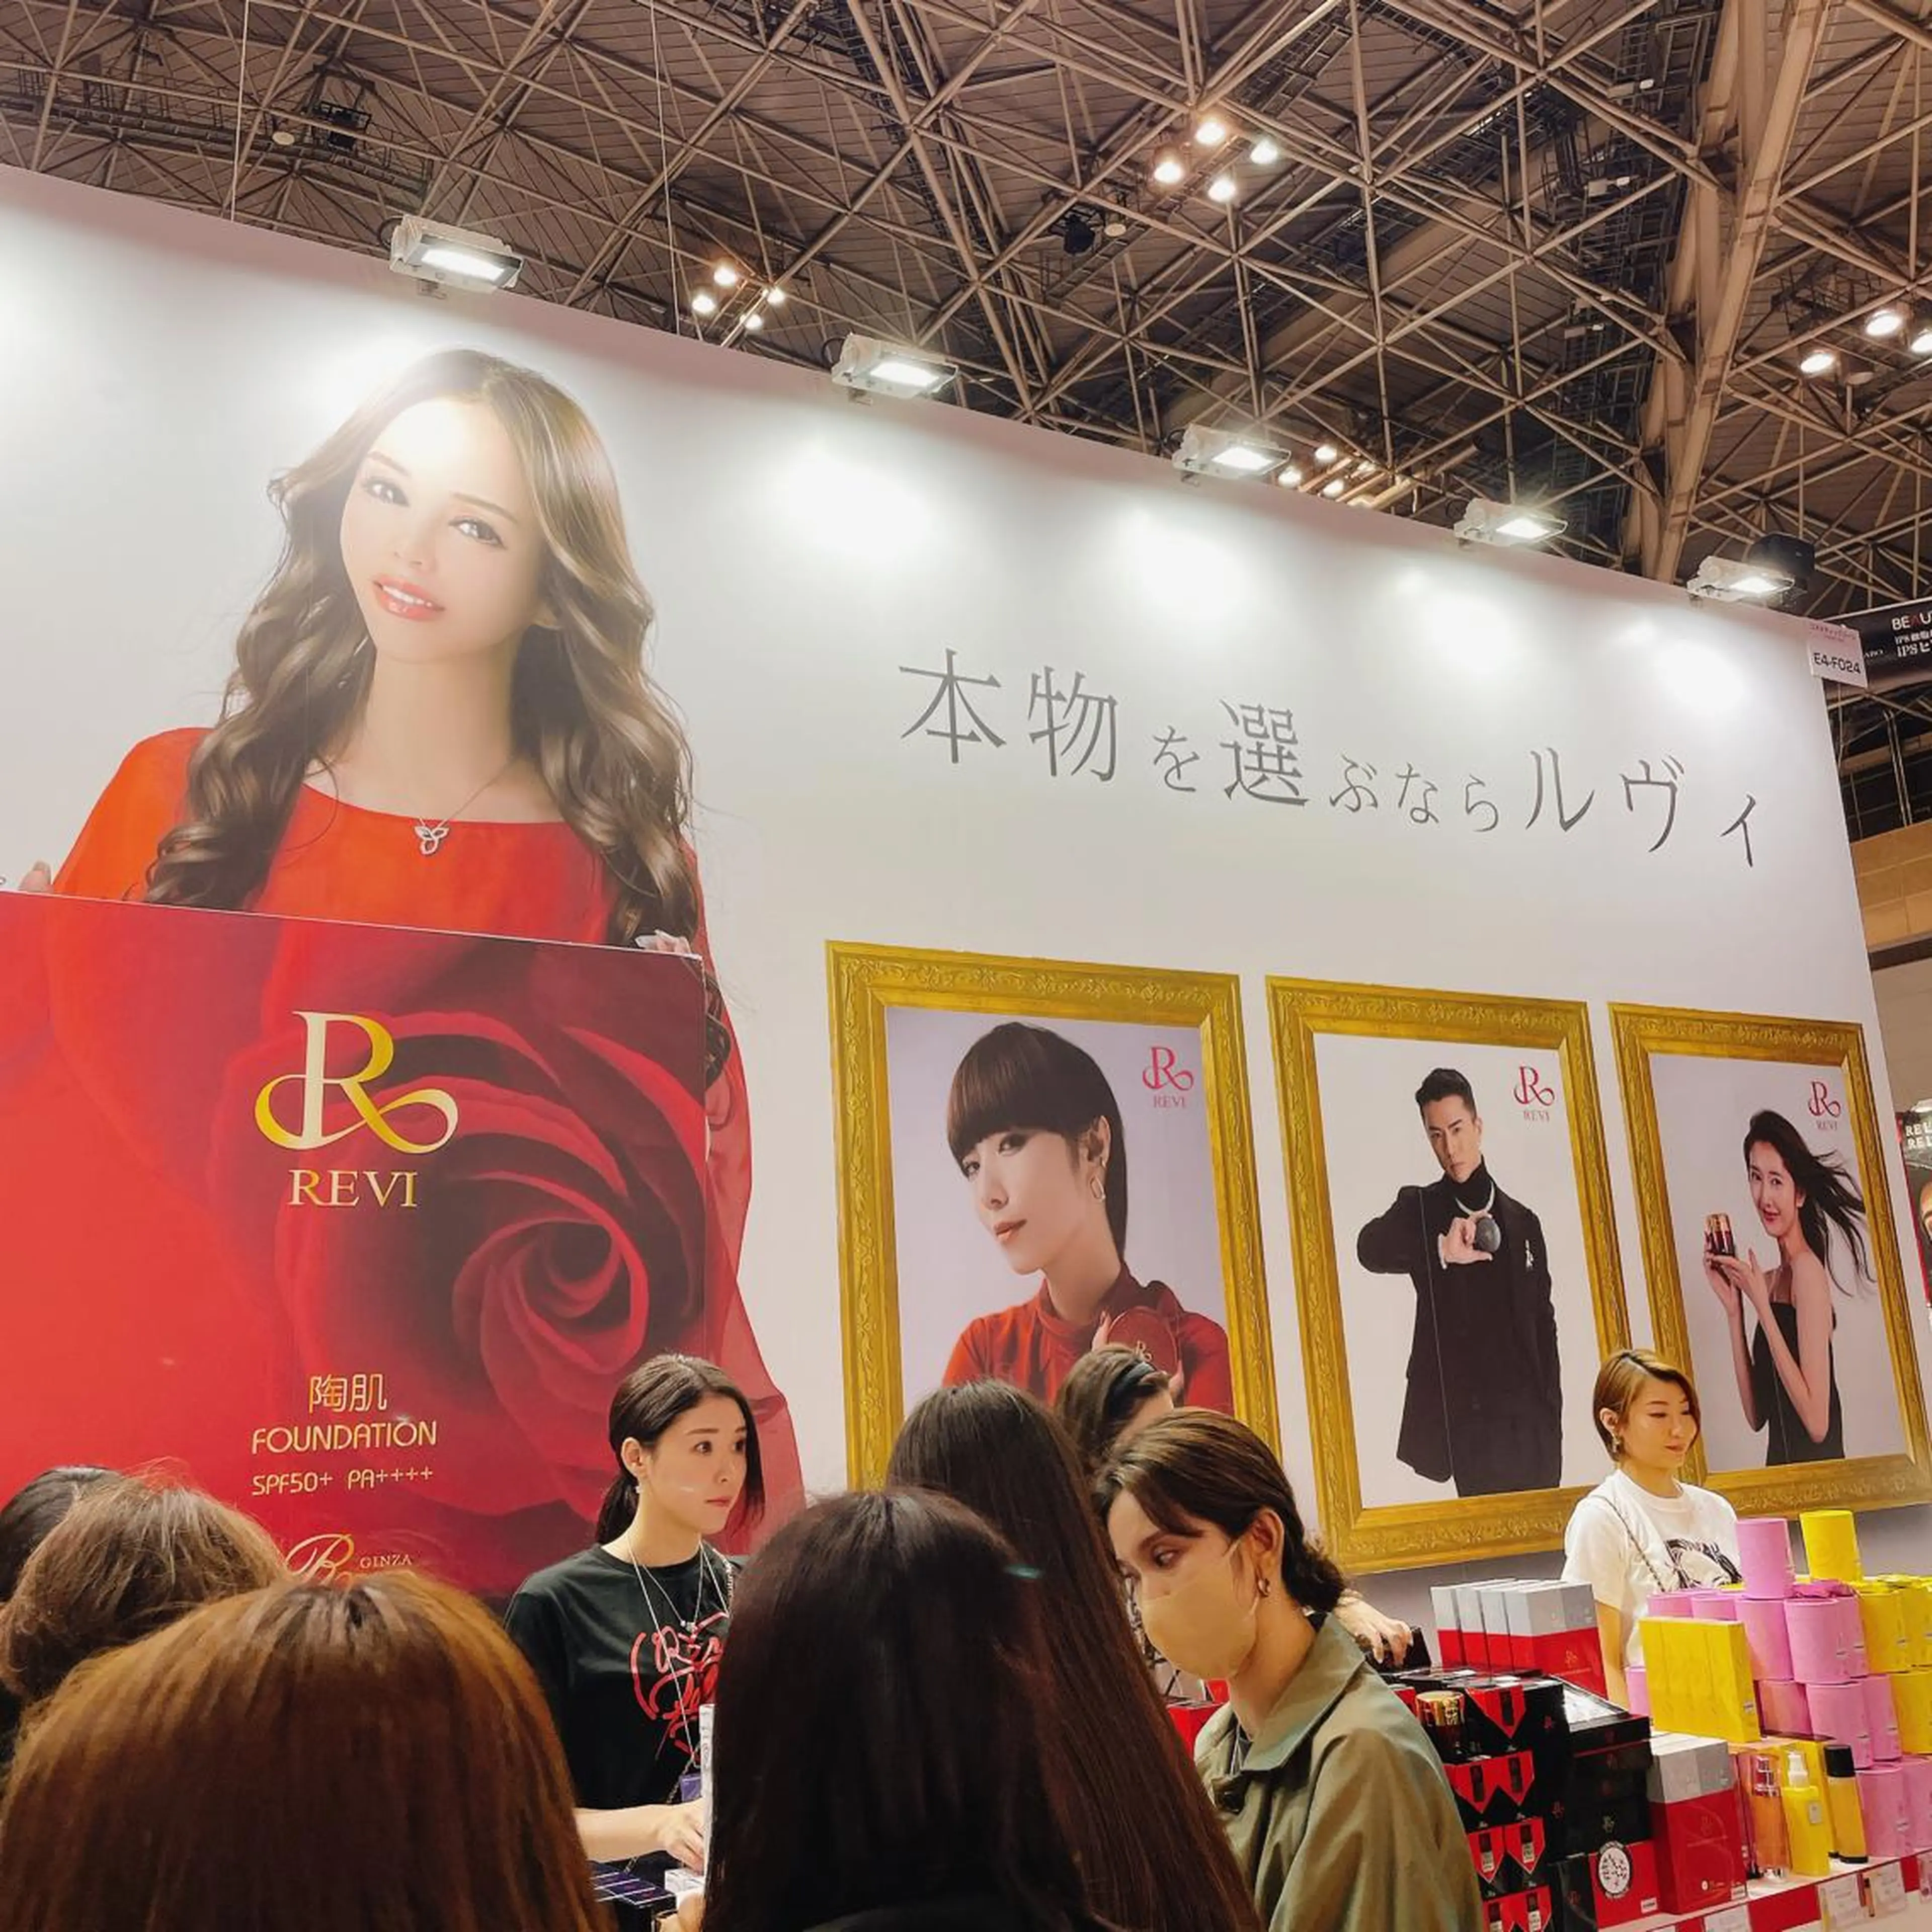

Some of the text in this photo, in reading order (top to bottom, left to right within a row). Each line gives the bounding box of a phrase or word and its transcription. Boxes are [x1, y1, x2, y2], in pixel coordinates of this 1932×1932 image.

[1813, 653, 1861, 674] E4-F024
[900, 650, 1757, 867] 本物を選ぶならルヴィ
[288, 1169, 417, 1207] REVI
[309, 1374, 387, 1413] 陶肌
[252, 1420, 437, 1454] FOUNDATION
[252, 1466, 434, 1495] SPF50+ PA++++
[359, 1554, 412, 1569] GINZA
